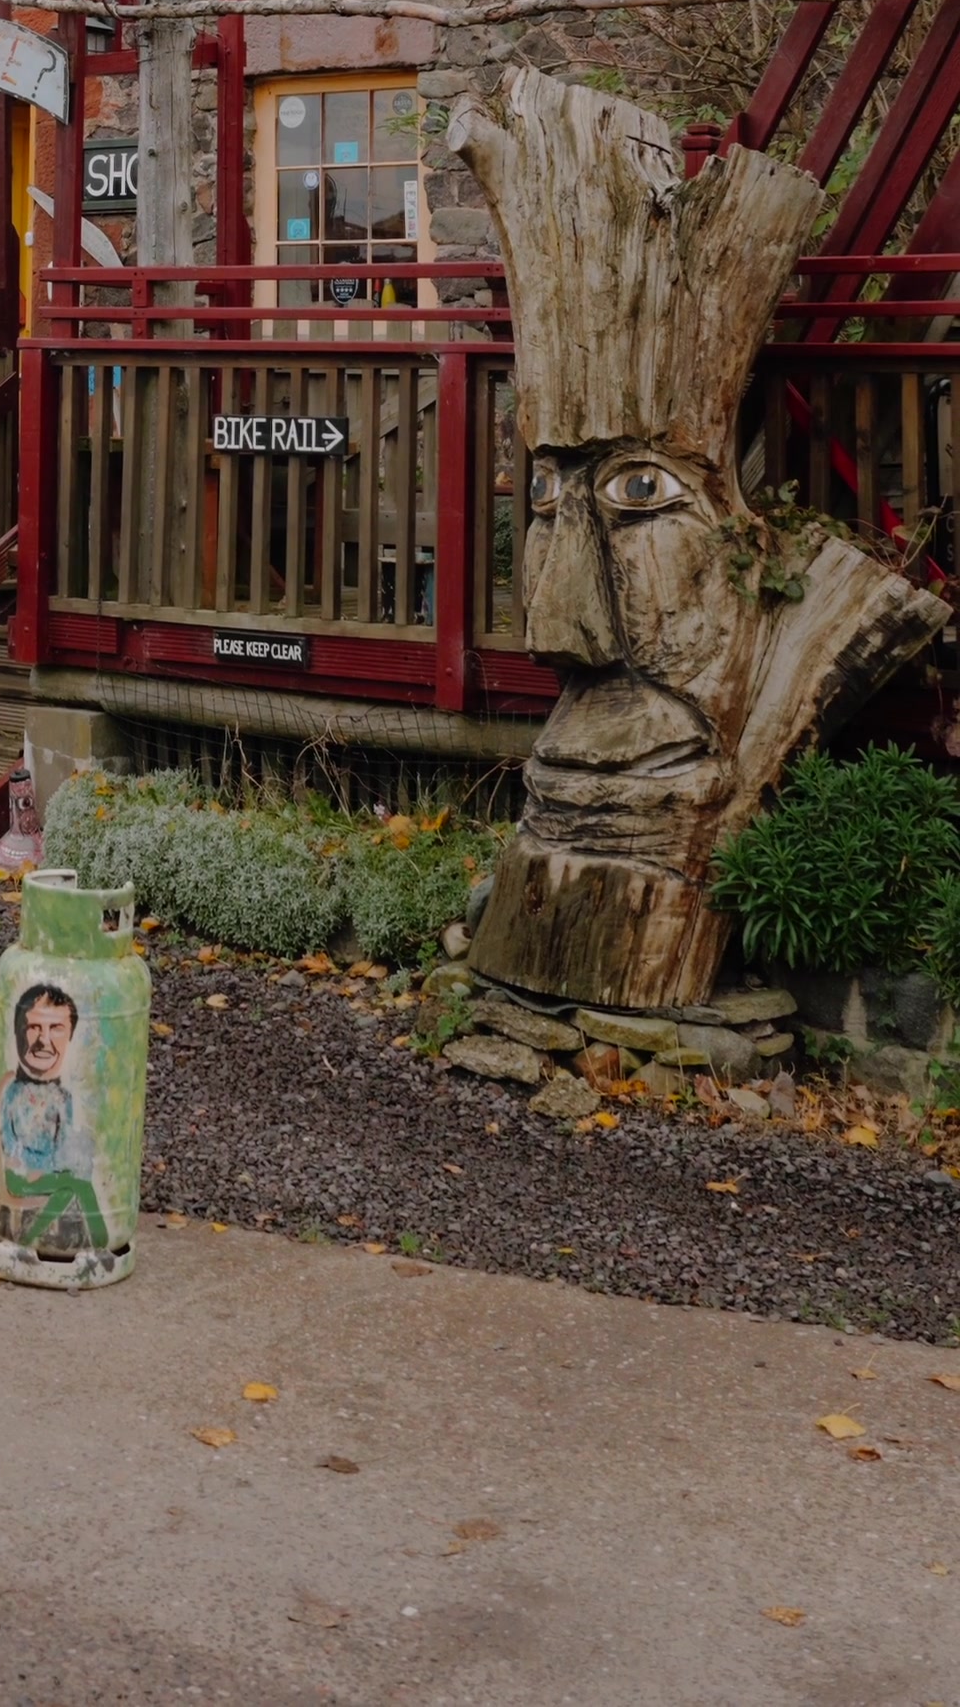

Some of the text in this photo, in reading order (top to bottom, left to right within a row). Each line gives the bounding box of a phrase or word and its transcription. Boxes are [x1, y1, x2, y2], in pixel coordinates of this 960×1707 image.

[213, 416, 326, 452] BIKE RAIL
[213, 638, 302, 662] PLEASE KEEP CLEAR
